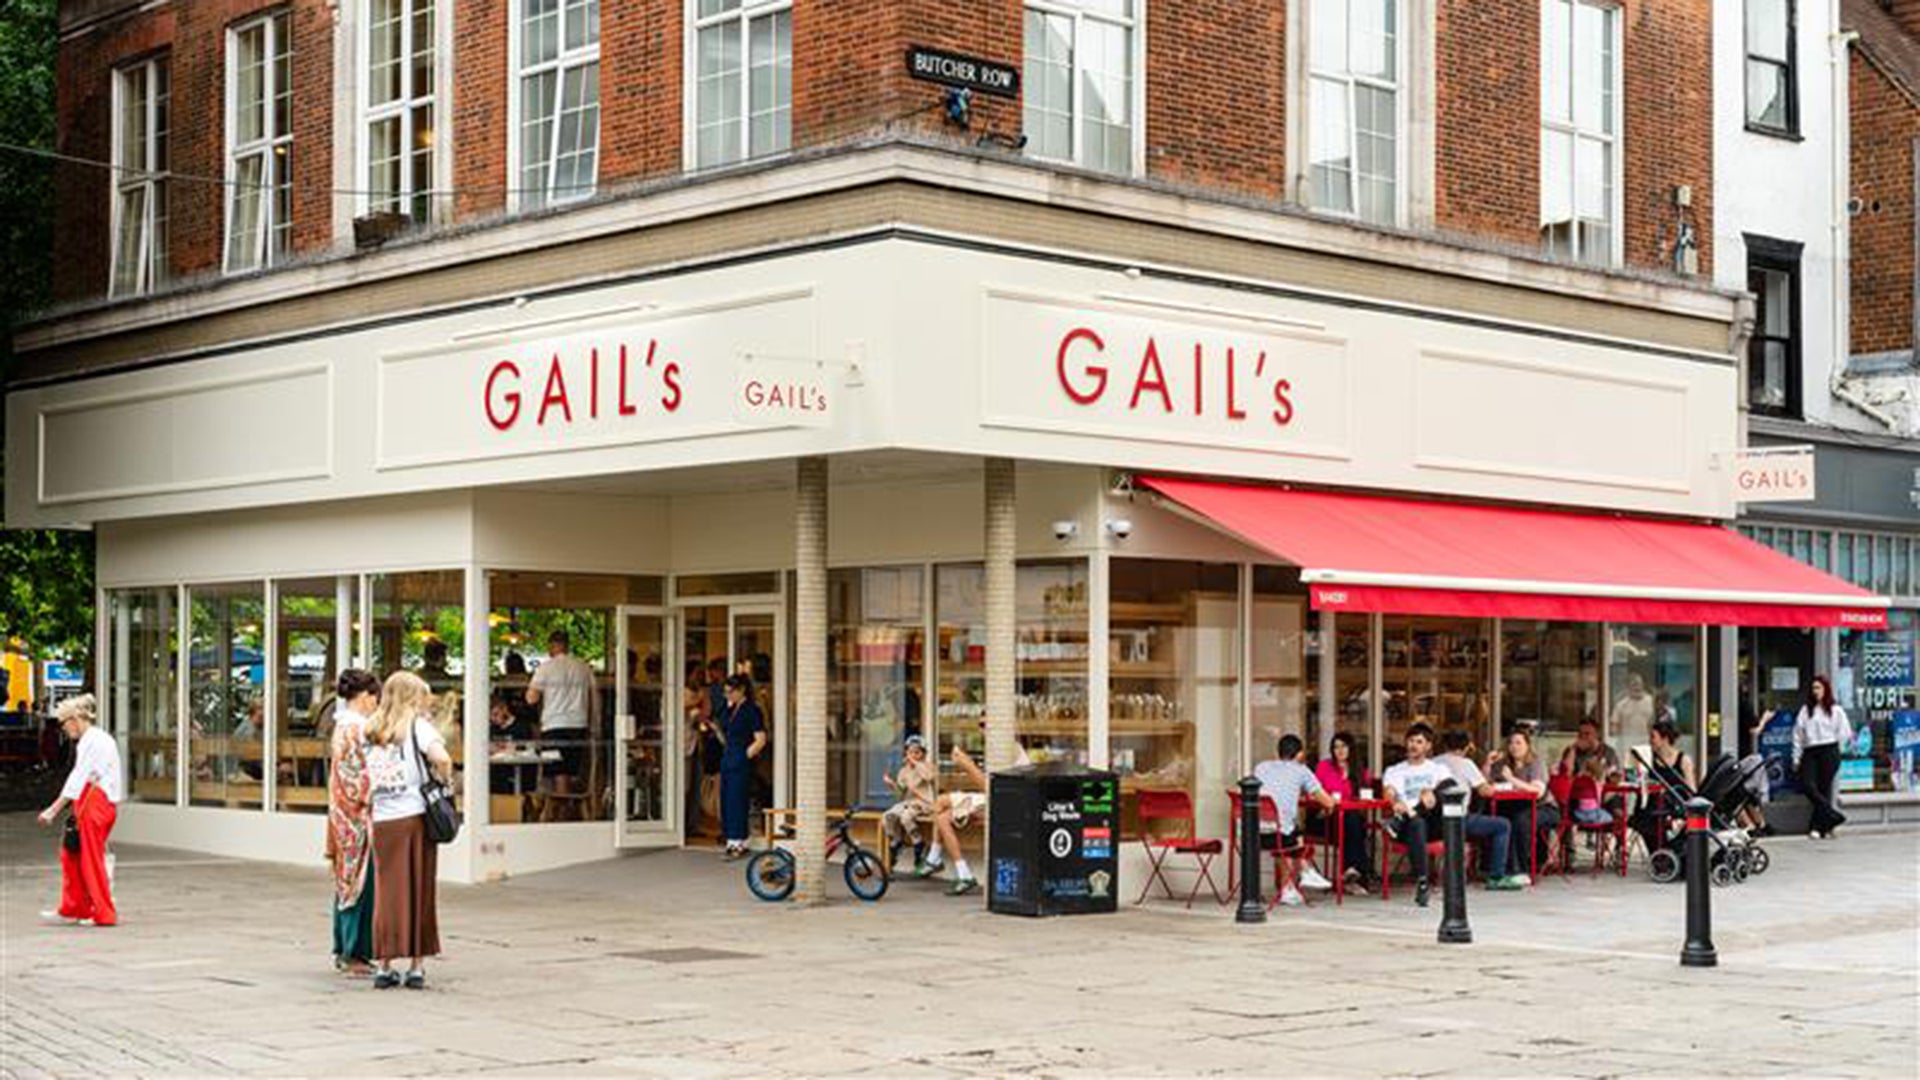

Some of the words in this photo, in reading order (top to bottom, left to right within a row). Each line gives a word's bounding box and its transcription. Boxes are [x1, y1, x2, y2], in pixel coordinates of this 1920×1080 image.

[914, 52, 977, 82] BUTCHER
[981, 65, 1013, 87] ROW
[484, 338, 682, 431] GAIL's
[1056, 327, 1293, 426] GAIL's
[745, 380, 827, 411] GAIL's
[1738, 468, 1808, 490] GAIL's
[1857, 686, 1909, 708] TIDAL
